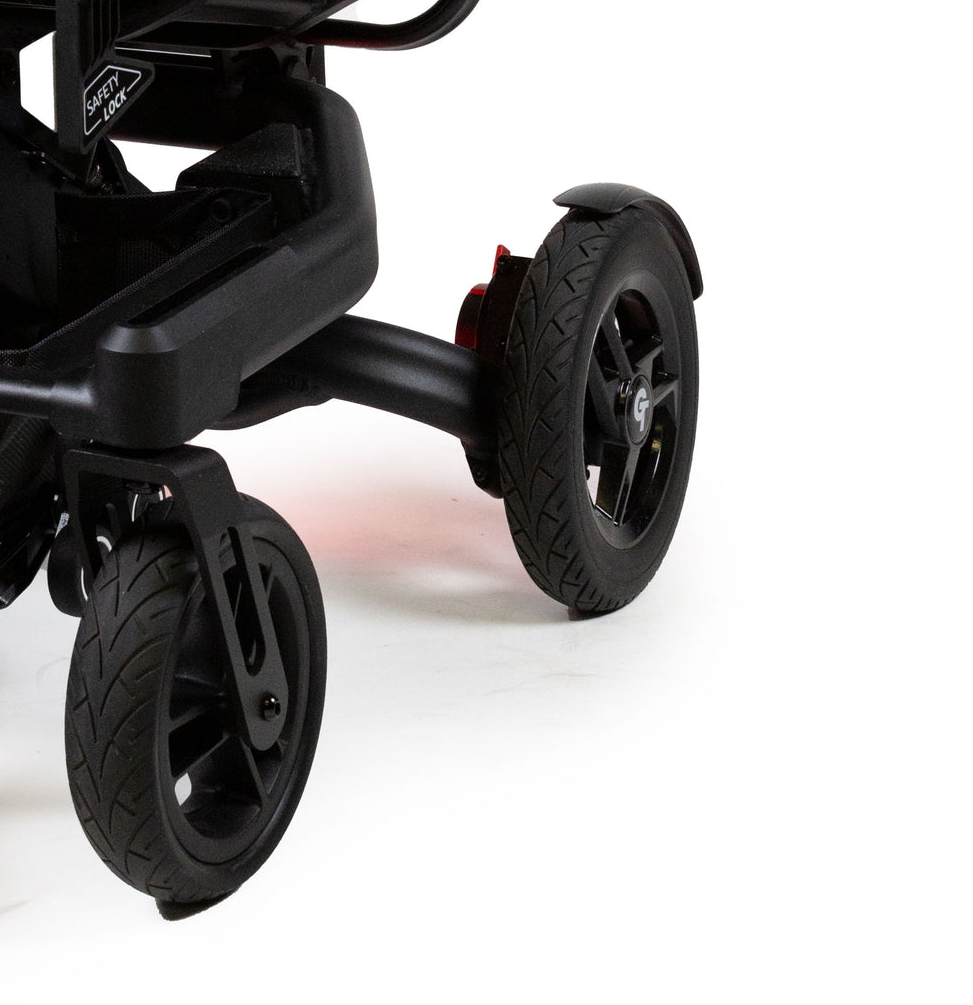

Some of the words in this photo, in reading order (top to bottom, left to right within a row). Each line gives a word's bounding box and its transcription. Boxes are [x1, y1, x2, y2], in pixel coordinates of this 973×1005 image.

[87, 71, 119, 116] SAFETY
[104, 87, 127, 122] LOCK
[634, 388, 649, 432] GT
